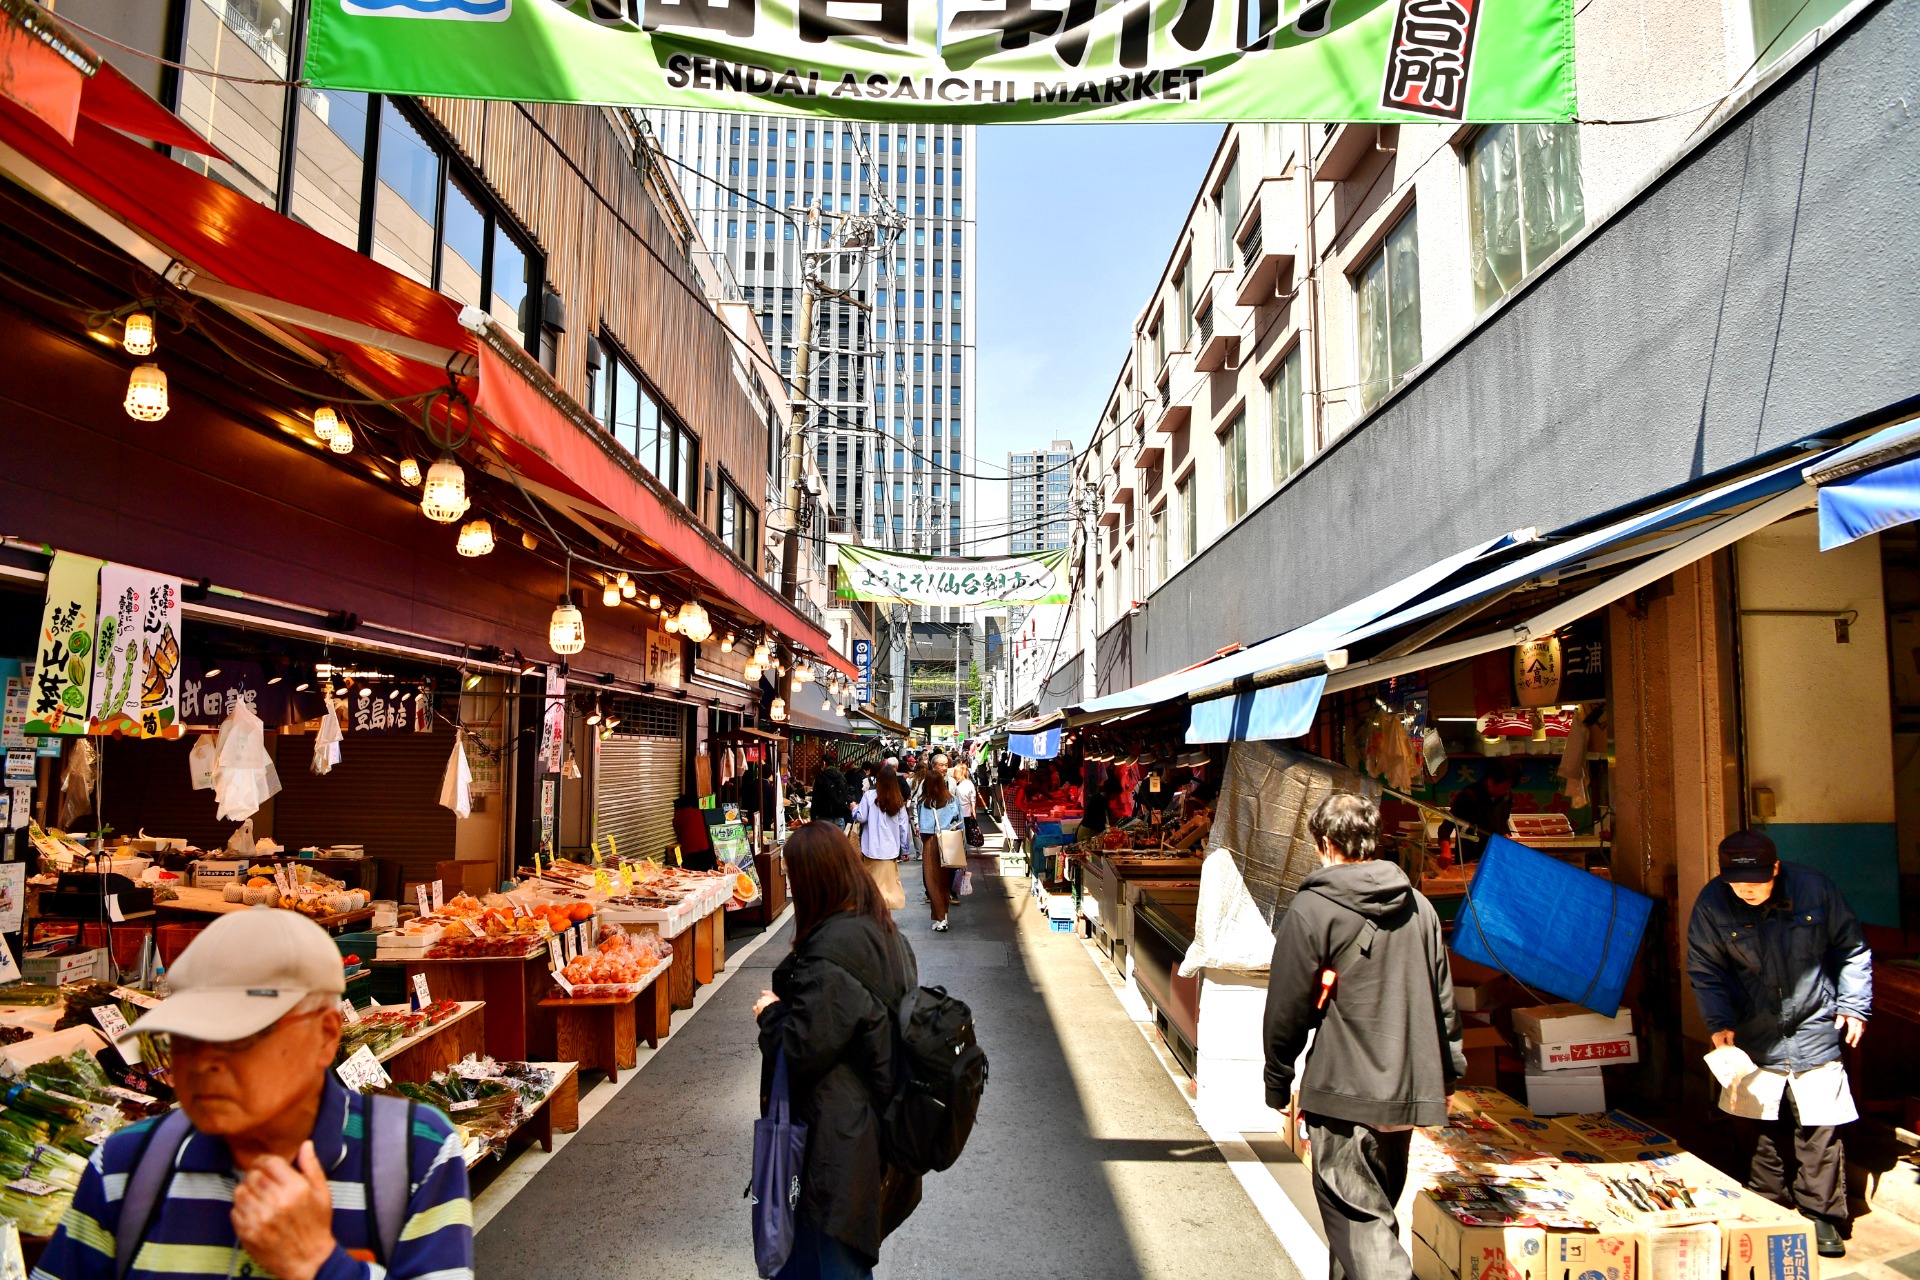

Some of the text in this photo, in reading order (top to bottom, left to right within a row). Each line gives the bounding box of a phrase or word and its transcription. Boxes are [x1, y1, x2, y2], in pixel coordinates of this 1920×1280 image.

[667, 65, 1204, 104] SENDAI ASAICHI MARKET
[1567, 641, 1603, 676] 三浦
